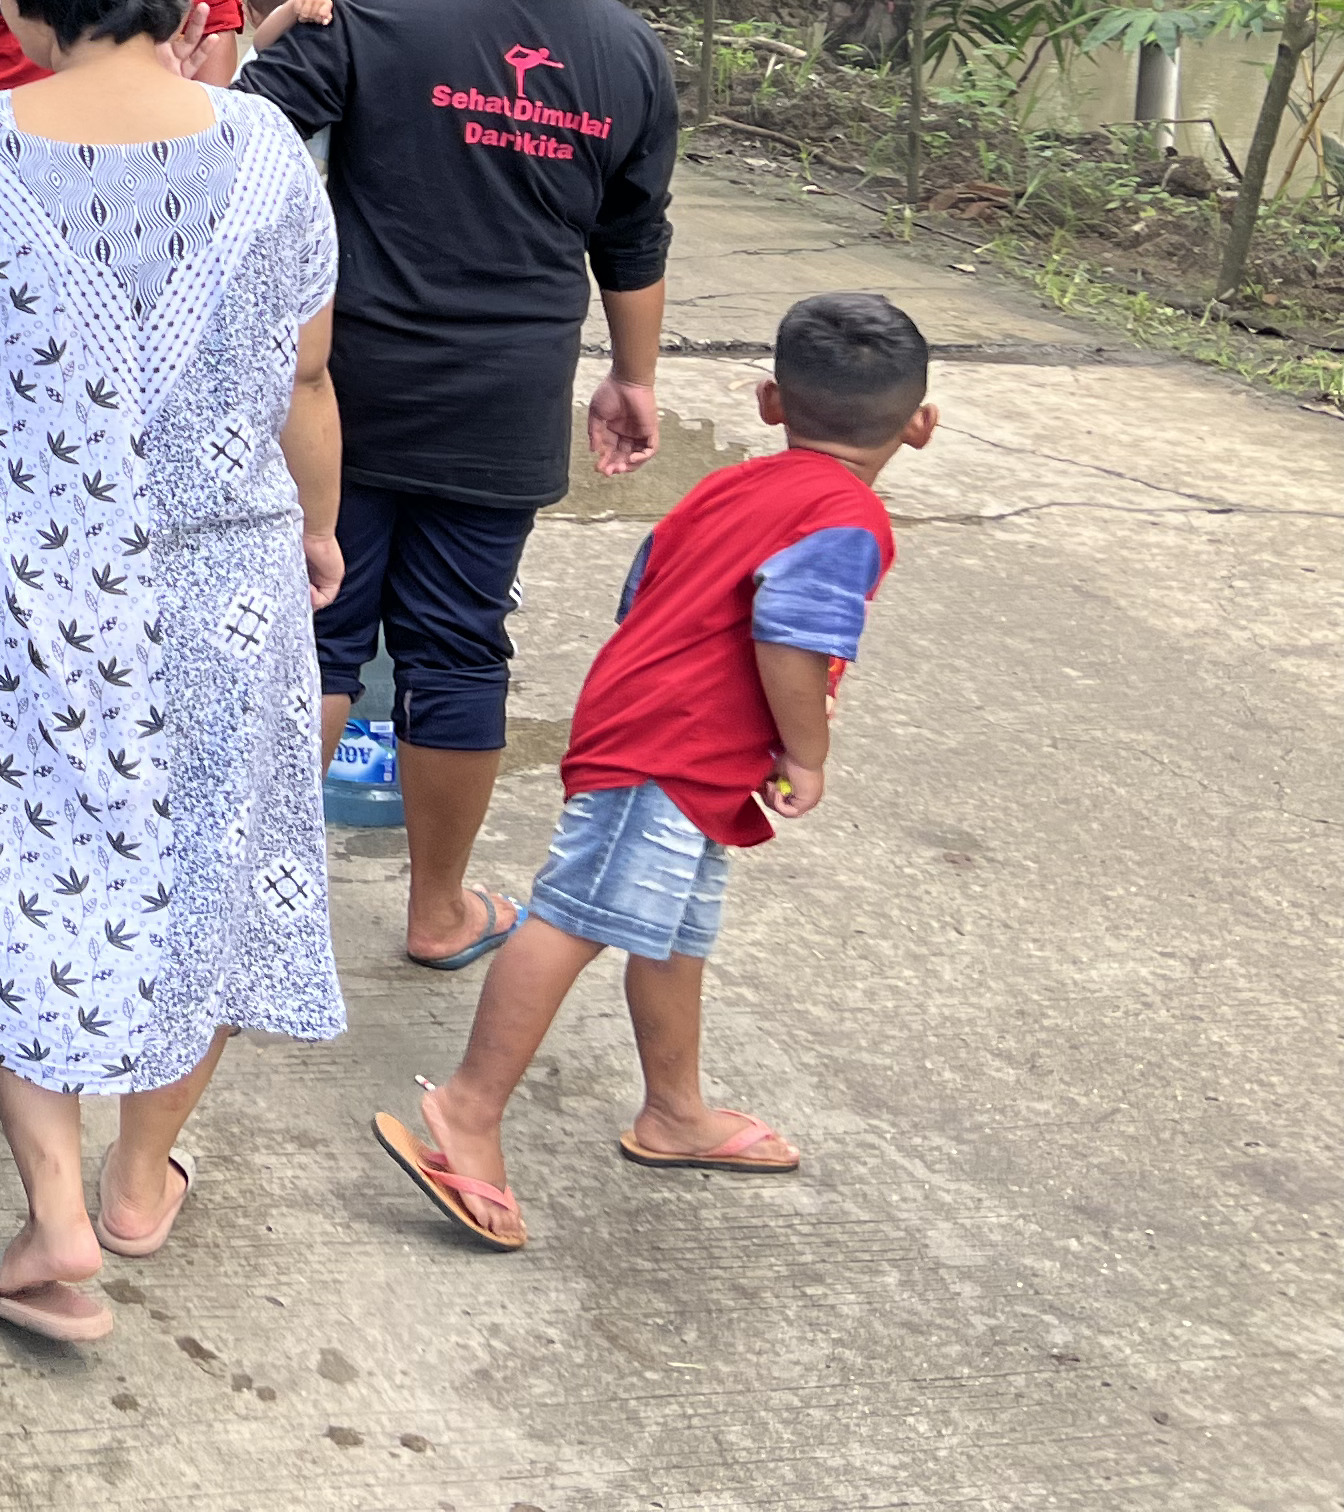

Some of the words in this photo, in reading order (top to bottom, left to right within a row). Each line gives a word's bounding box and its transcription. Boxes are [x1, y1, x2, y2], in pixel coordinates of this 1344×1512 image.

[431, 84, 511, 117] Sehat
[513, 98, 612, 139] Dimulai
[333, 742, 373, 765] AQU
